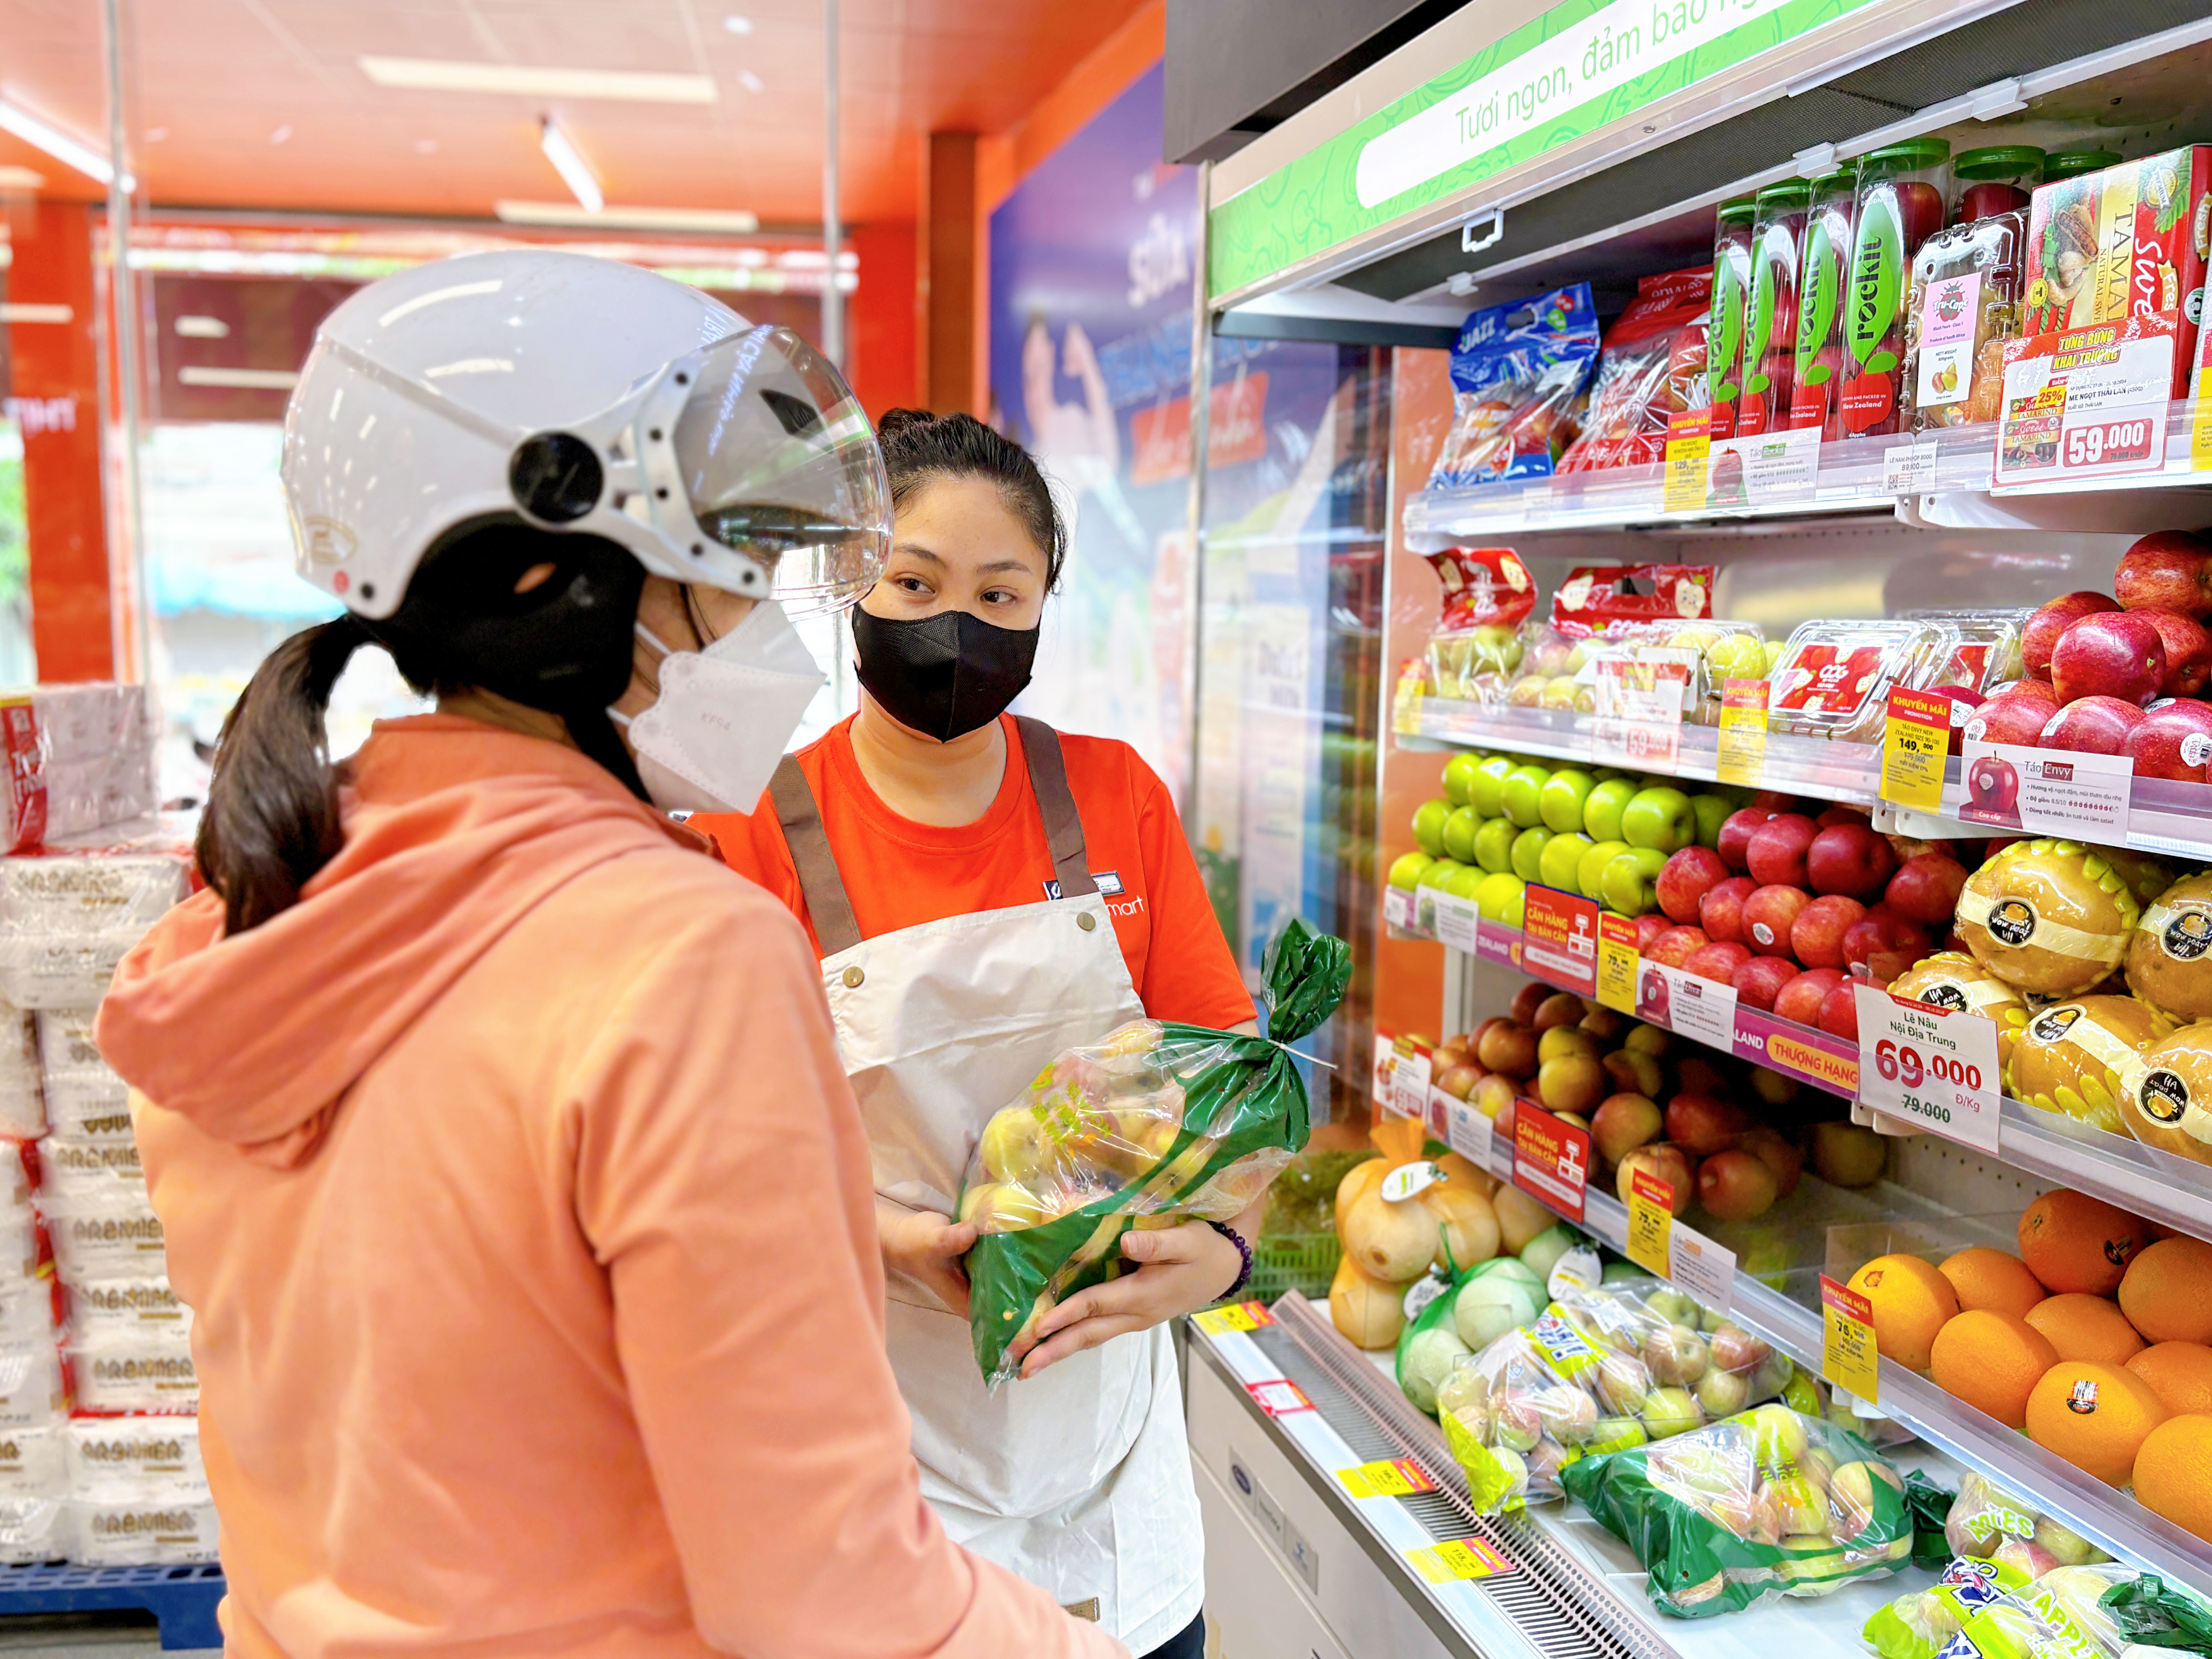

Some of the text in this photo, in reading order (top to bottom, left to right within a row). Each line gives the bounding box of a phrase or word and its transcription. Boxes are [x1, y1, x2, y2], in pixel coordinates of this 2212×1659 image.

[1456, 25, 1640, 145] Tươi ngon, đảm
[1874, 181, 1888, 190] and
[2197, 203, 2211, 249] Fresh
[2094, 248, 2107, 299] NATURAL
[1933, 298, 1968, 312] Tru-Cape
[2052, 355, 2077, 370] KHAI
[2039, 389, 2063, 403] 25%
[2080, 392, 2096, 400] NGỌT
[2098, 387, 2112, 397] THÁI
[2017, 408, 2057, 419] TAMARIND
[2012, 432, 2051, 443] TAMARIND
[2068, 421, 2145, 464] 59.000
[1893, 696, 1947, 716] KHUYẾN MÃI
[1904, 710, 1933, 721] PROMOTION
[1895, 730, 1914, 739] ZEALAND
[1899, 738, 1919, 754] 149,
[2025, 760, 2071, 778] Táo Envy
[2031, 784, 2047, 792] Hương
[1990, 811, 2001, 821] cấp
[2029, 807, 2043, 815] Dùng
[1106, 895, 1144, 916] mart
[1545, 912, 1568, 930] HÀNG
[1539, 926, 1552, 938] BÀN
[1904, 1012, 1938, 1030] Lê Nâu
[1890, 1021, 1956, 1050] Nội Địa Trung
[1775, 1042, 1858, 1084] THƯỢNG HẠNG
[1876, 1039, 1981, 1091] 69.000
[1902, 1094, 1951, 1123] 79.000
[1955, 1094, 1980, 1113] Đ/Kg
[1535, 1131, 1558, 1153] HÀNG
